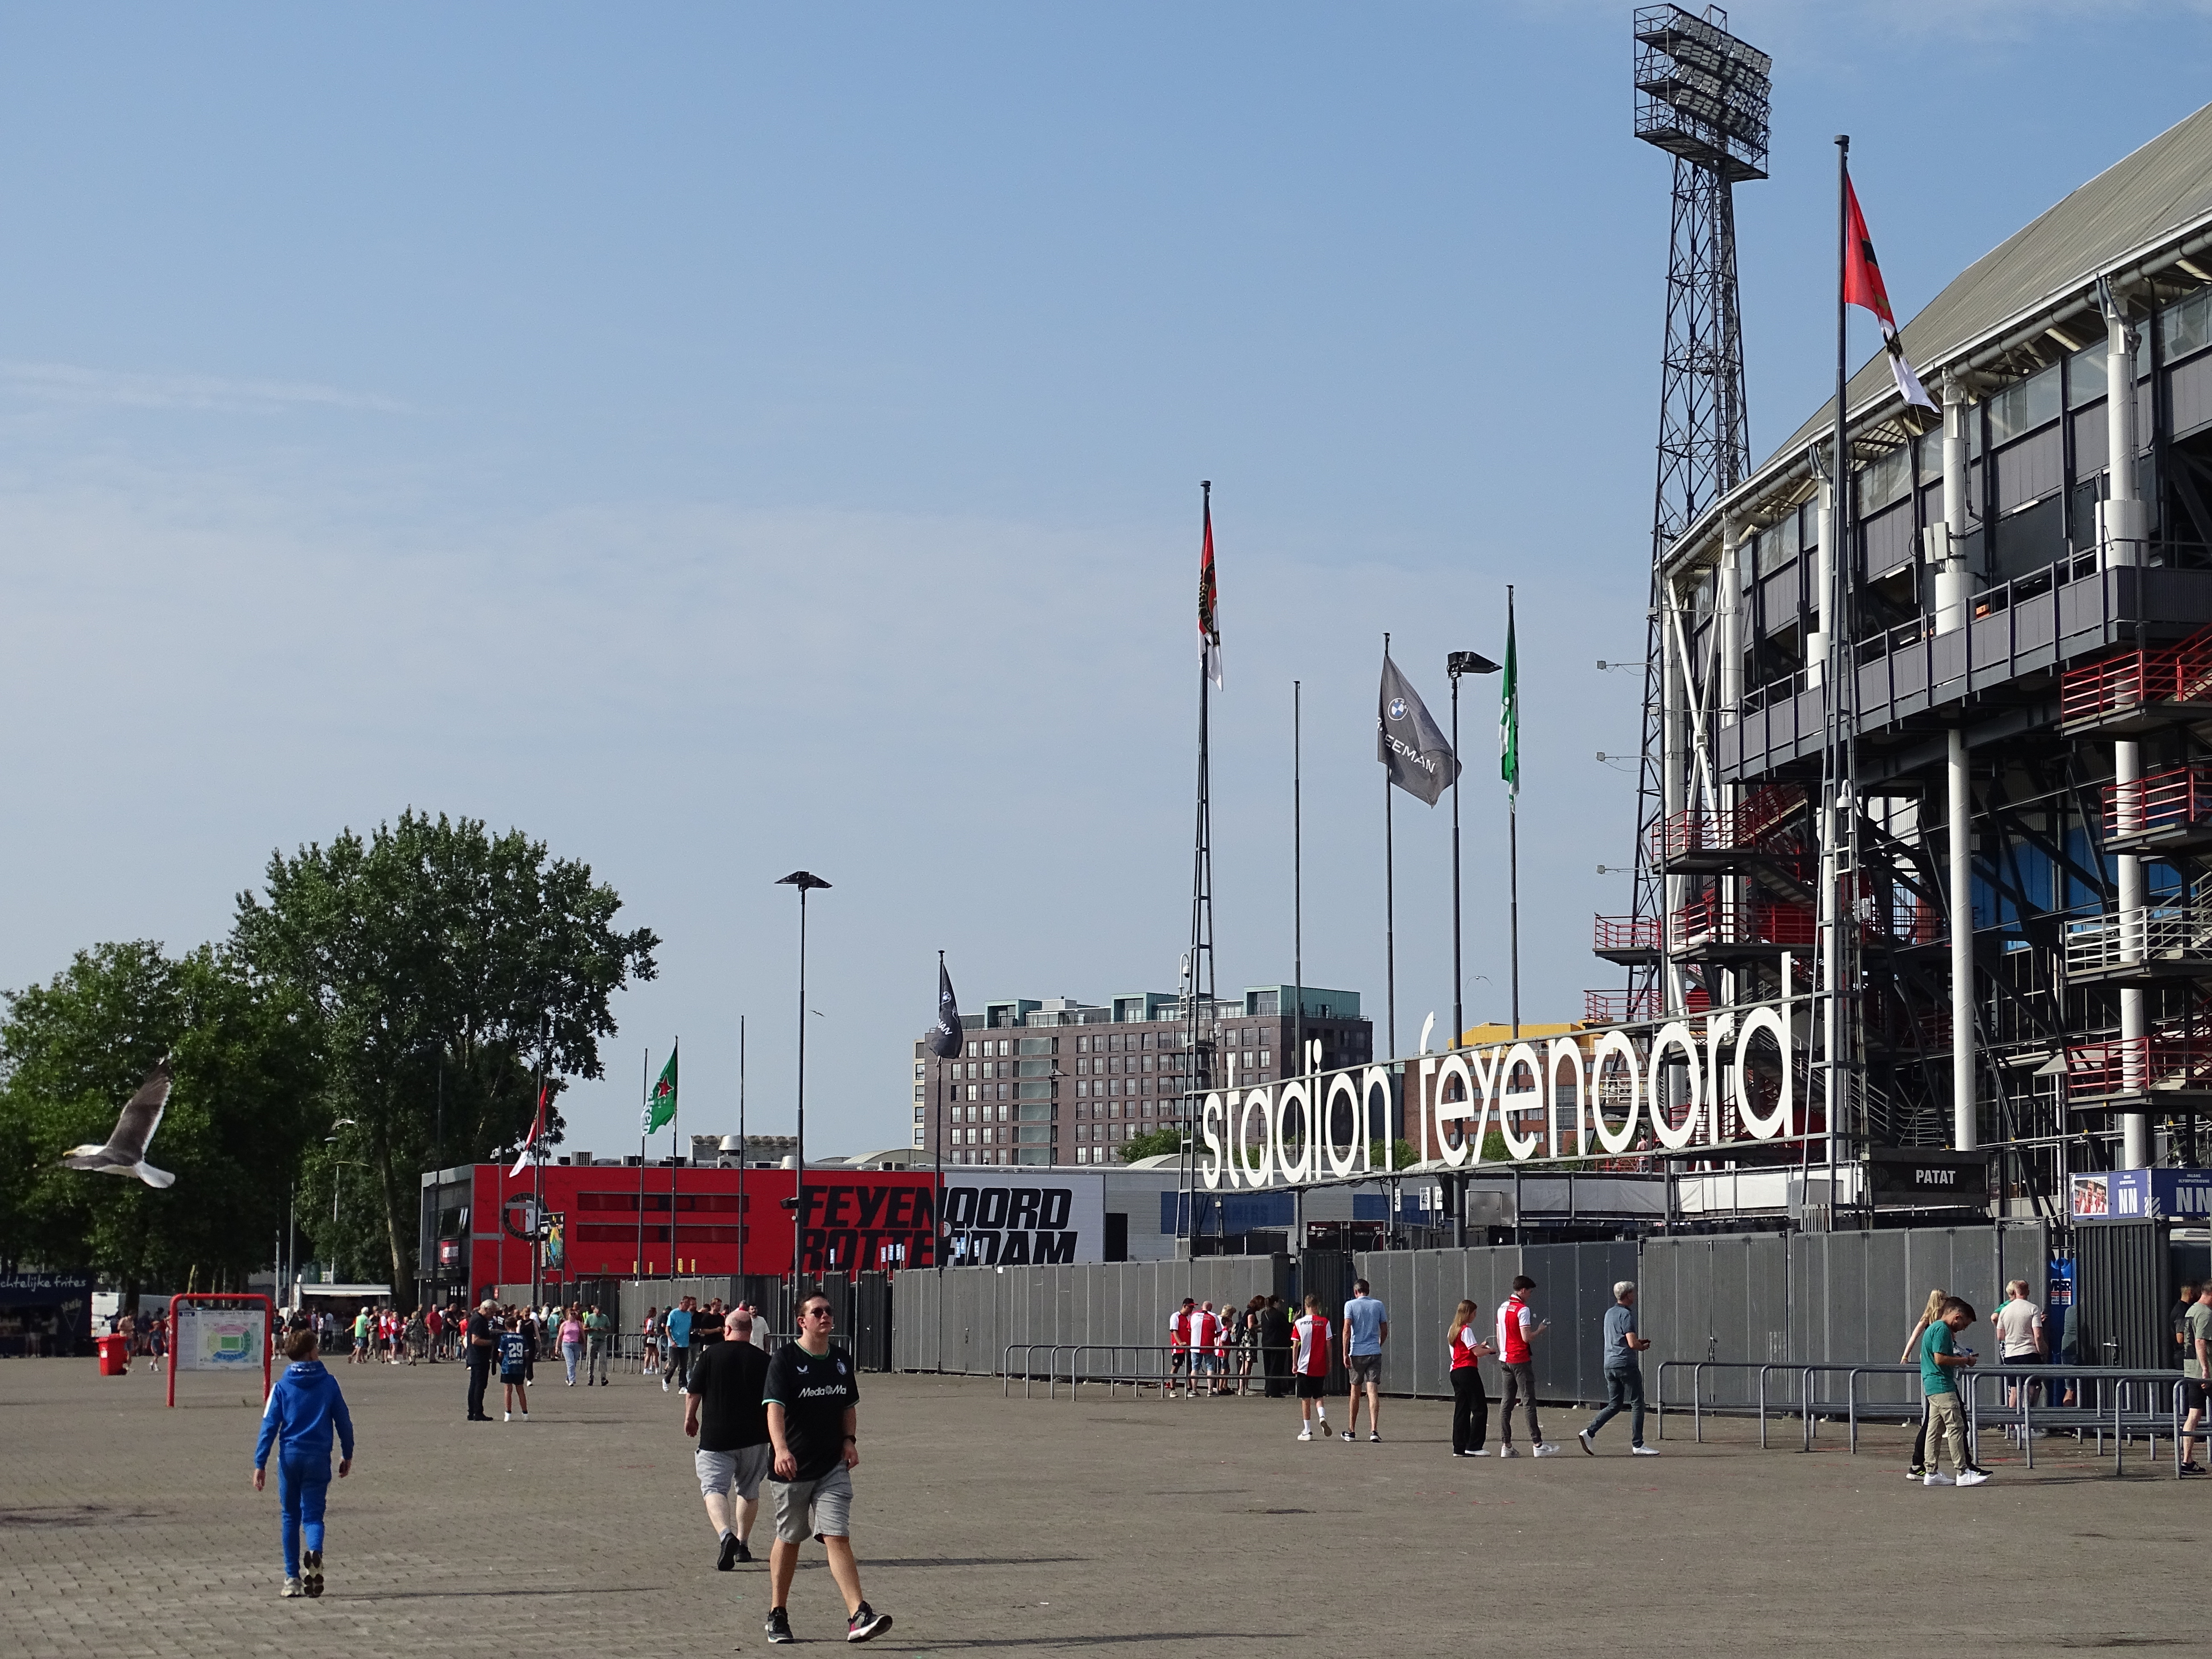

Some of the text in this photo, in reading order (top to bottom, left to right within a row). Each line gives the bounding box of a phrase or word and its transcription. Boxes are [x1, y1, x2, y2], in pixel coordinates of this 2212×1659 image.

[1202, 951, 1793, 1190] stadion feyenoord
[1916, 1170, 1956, 1184] PATAT
[797, 1185, 1073, 1230] FEYENOORD
[1421, 1193, 1428, 1205] 43
[2118, 1188, 2138, 1214] NN
[2176, 1187, 2212, 1213] NN
[54, 1275, 86, 1287] frites
[508, 1342, 523, 1358] 29
